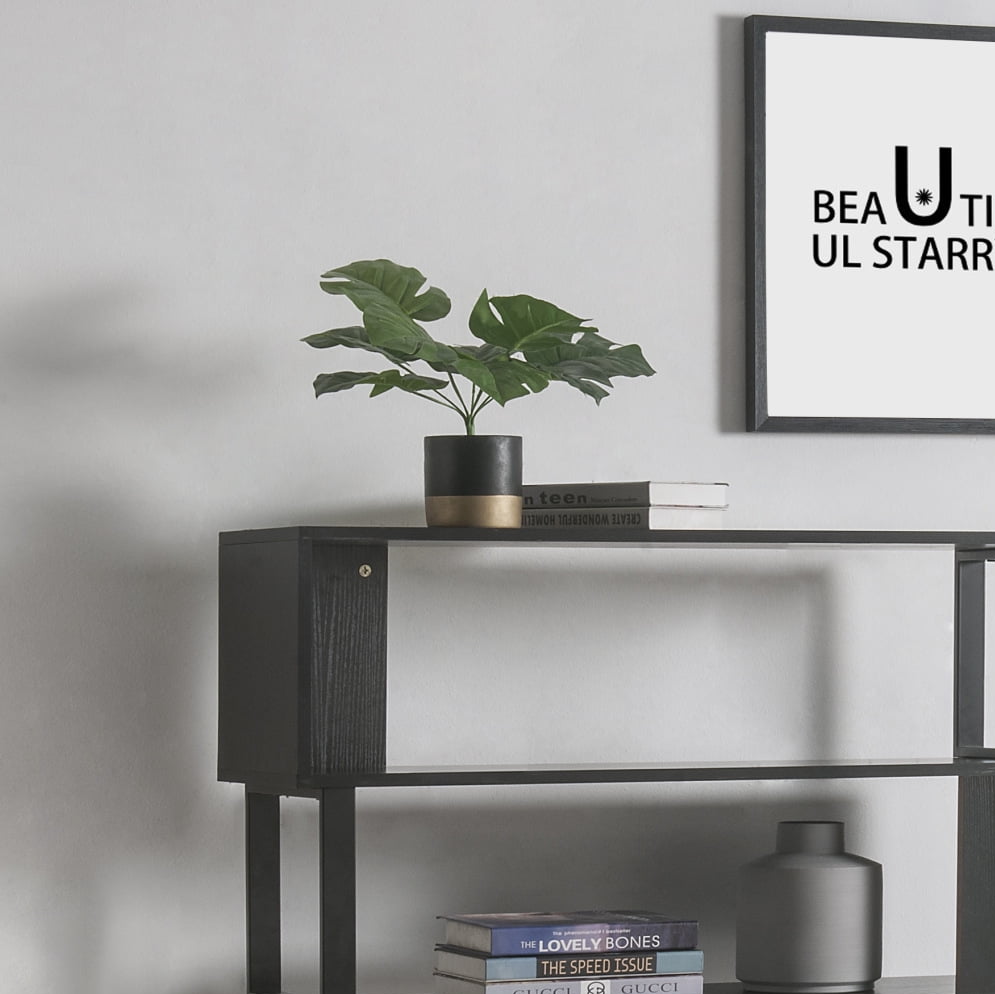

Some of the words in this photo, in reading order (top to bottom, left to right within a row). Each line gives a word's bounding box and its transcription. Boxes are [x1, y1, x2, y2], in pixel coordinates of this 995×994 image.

[812, 234, 862, 268] UL
[539, 491, 587, 504] teen
[558, 514, 610, 526] WONDERFUL
[612, 513, 640, 526] CREATE
[520, 940, 536, 949] THE
[538, 938, 602, 952] LOVELY
[606, 935, 660, 950] BONES
[542, 961, 566, 976] THE
[570, 959, 611, 974] SPEED
[614, 957, 654, 972] ISSUE
